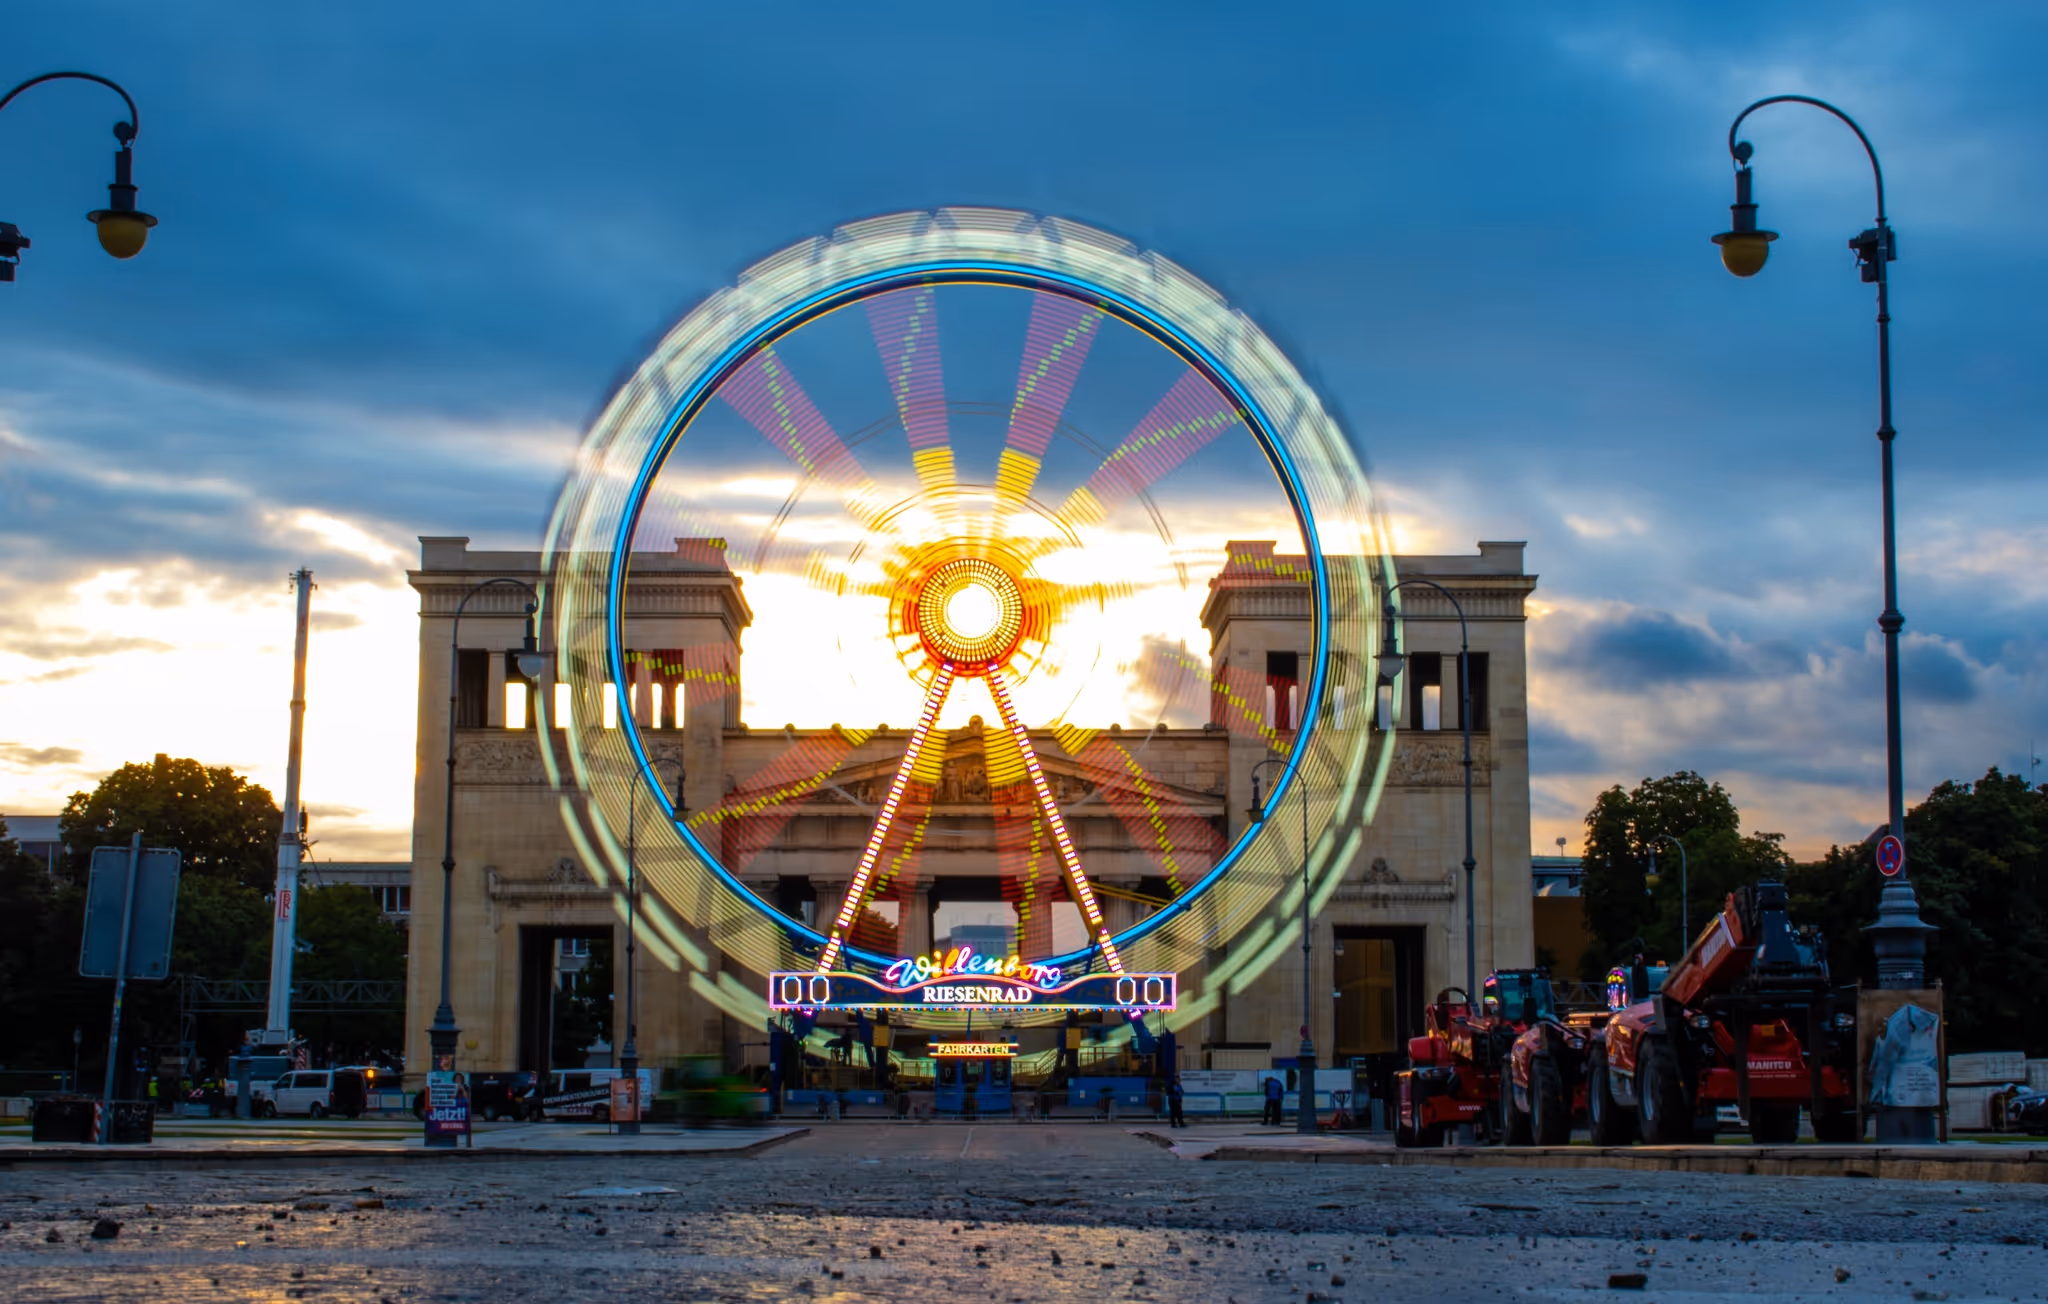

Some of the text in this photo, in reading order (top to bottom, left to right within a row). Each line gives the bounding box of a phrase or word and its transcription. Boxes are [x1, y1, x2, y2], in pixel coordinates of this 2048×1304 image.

[885, 946, 1062, 988] Willenborg
[923, 986, 1033, 1003] RIESENRAD
[937, 1044, 1009, 1055] FAHRKARTEN
[1747, 1061, 1791, 1070] MANITOU
[429, 1107, 466, 1121] Jetzt!
